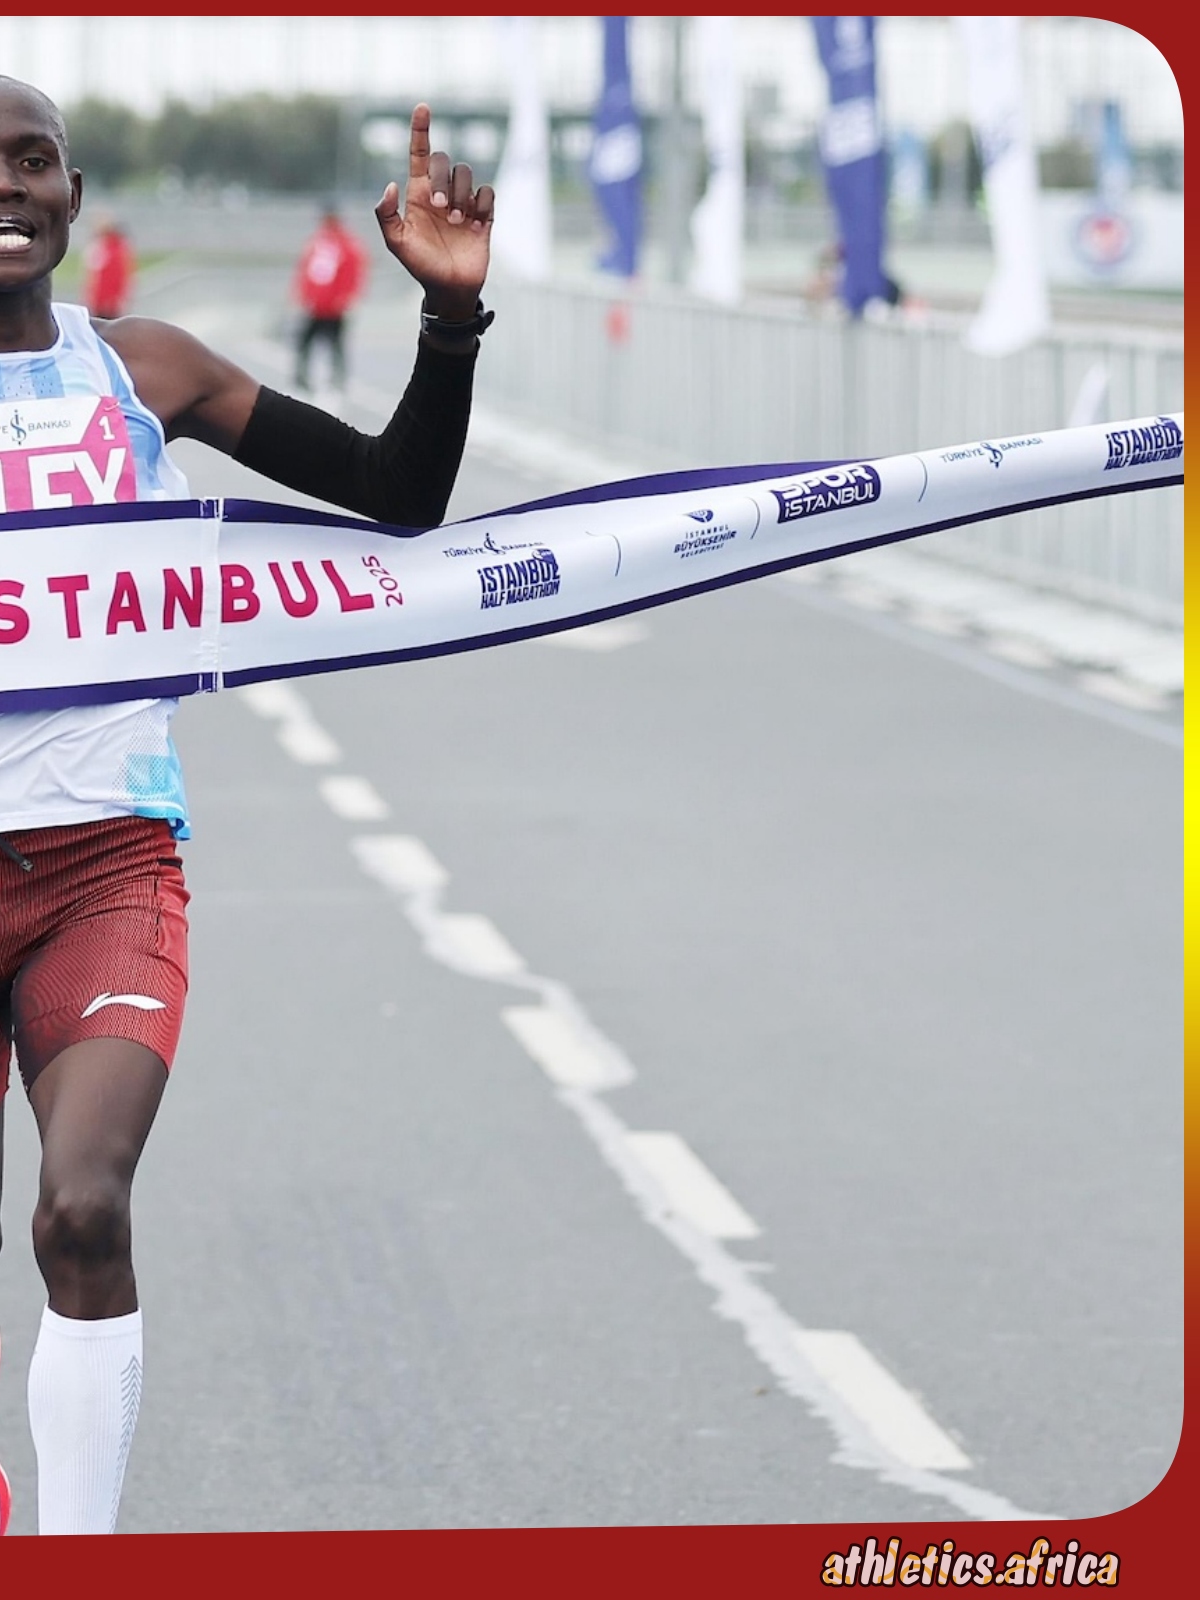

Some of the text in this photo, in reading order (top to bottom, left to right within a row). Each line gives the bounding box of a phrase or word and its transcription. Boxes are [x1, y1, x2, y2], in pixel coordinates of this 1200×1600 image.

[27, 419, 72, 433] BANKASI
[98, 415, 116, 441] 1
[940, 436, 1043, 464] TÜRKİYE BANKASI
[778, 464, 874, 499] SPOR
[361, 554, 404, 607] 2025
[480, 580, 561, 610] HALF MARATHON
